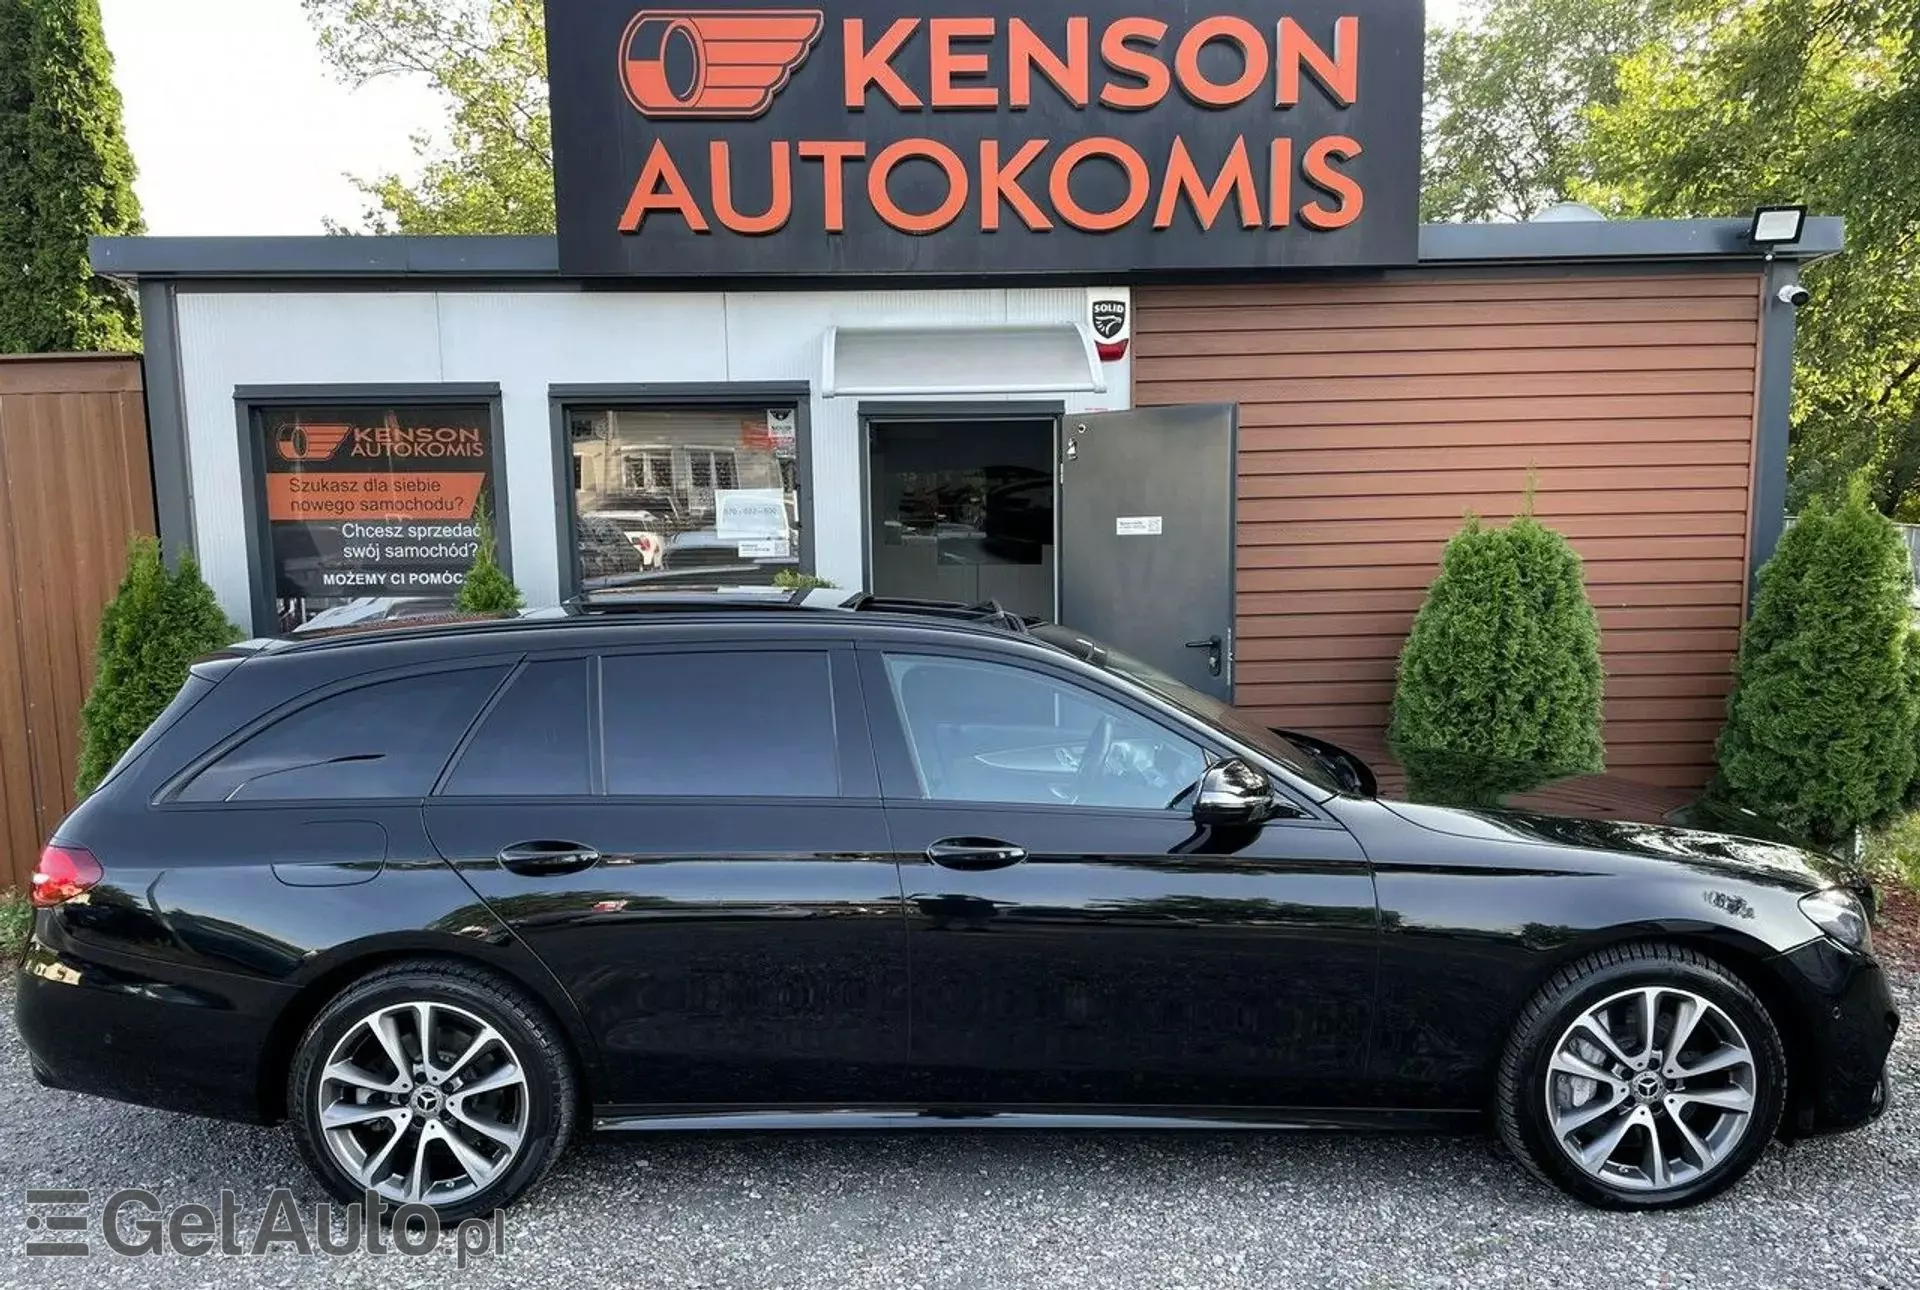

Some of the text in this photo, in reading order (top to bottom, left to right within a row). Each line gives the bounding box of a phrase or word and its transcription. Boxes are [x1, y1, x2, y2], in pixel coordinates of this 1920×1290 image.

[843, 15, 1360, 110] KENSON
[617, 135, 1365, 236] AUTOKOMIS
[1093, 303, 1125, 313] SOLID
[353, 427, 480, 442] KENSON
[350, 442, 484, 457] AUTOKOMIS
[289, 477, 441, 492] Szukasz dla siebie
[290, 497, 464, 515] nowego samochodu?
[341, 523, 481, 541] Chcesz sprzedać
[343, 542, 478, 561] swój samochód?
[323, 570, 387, 585] MOŻEMY
[390, 573, 405, 585] CI
